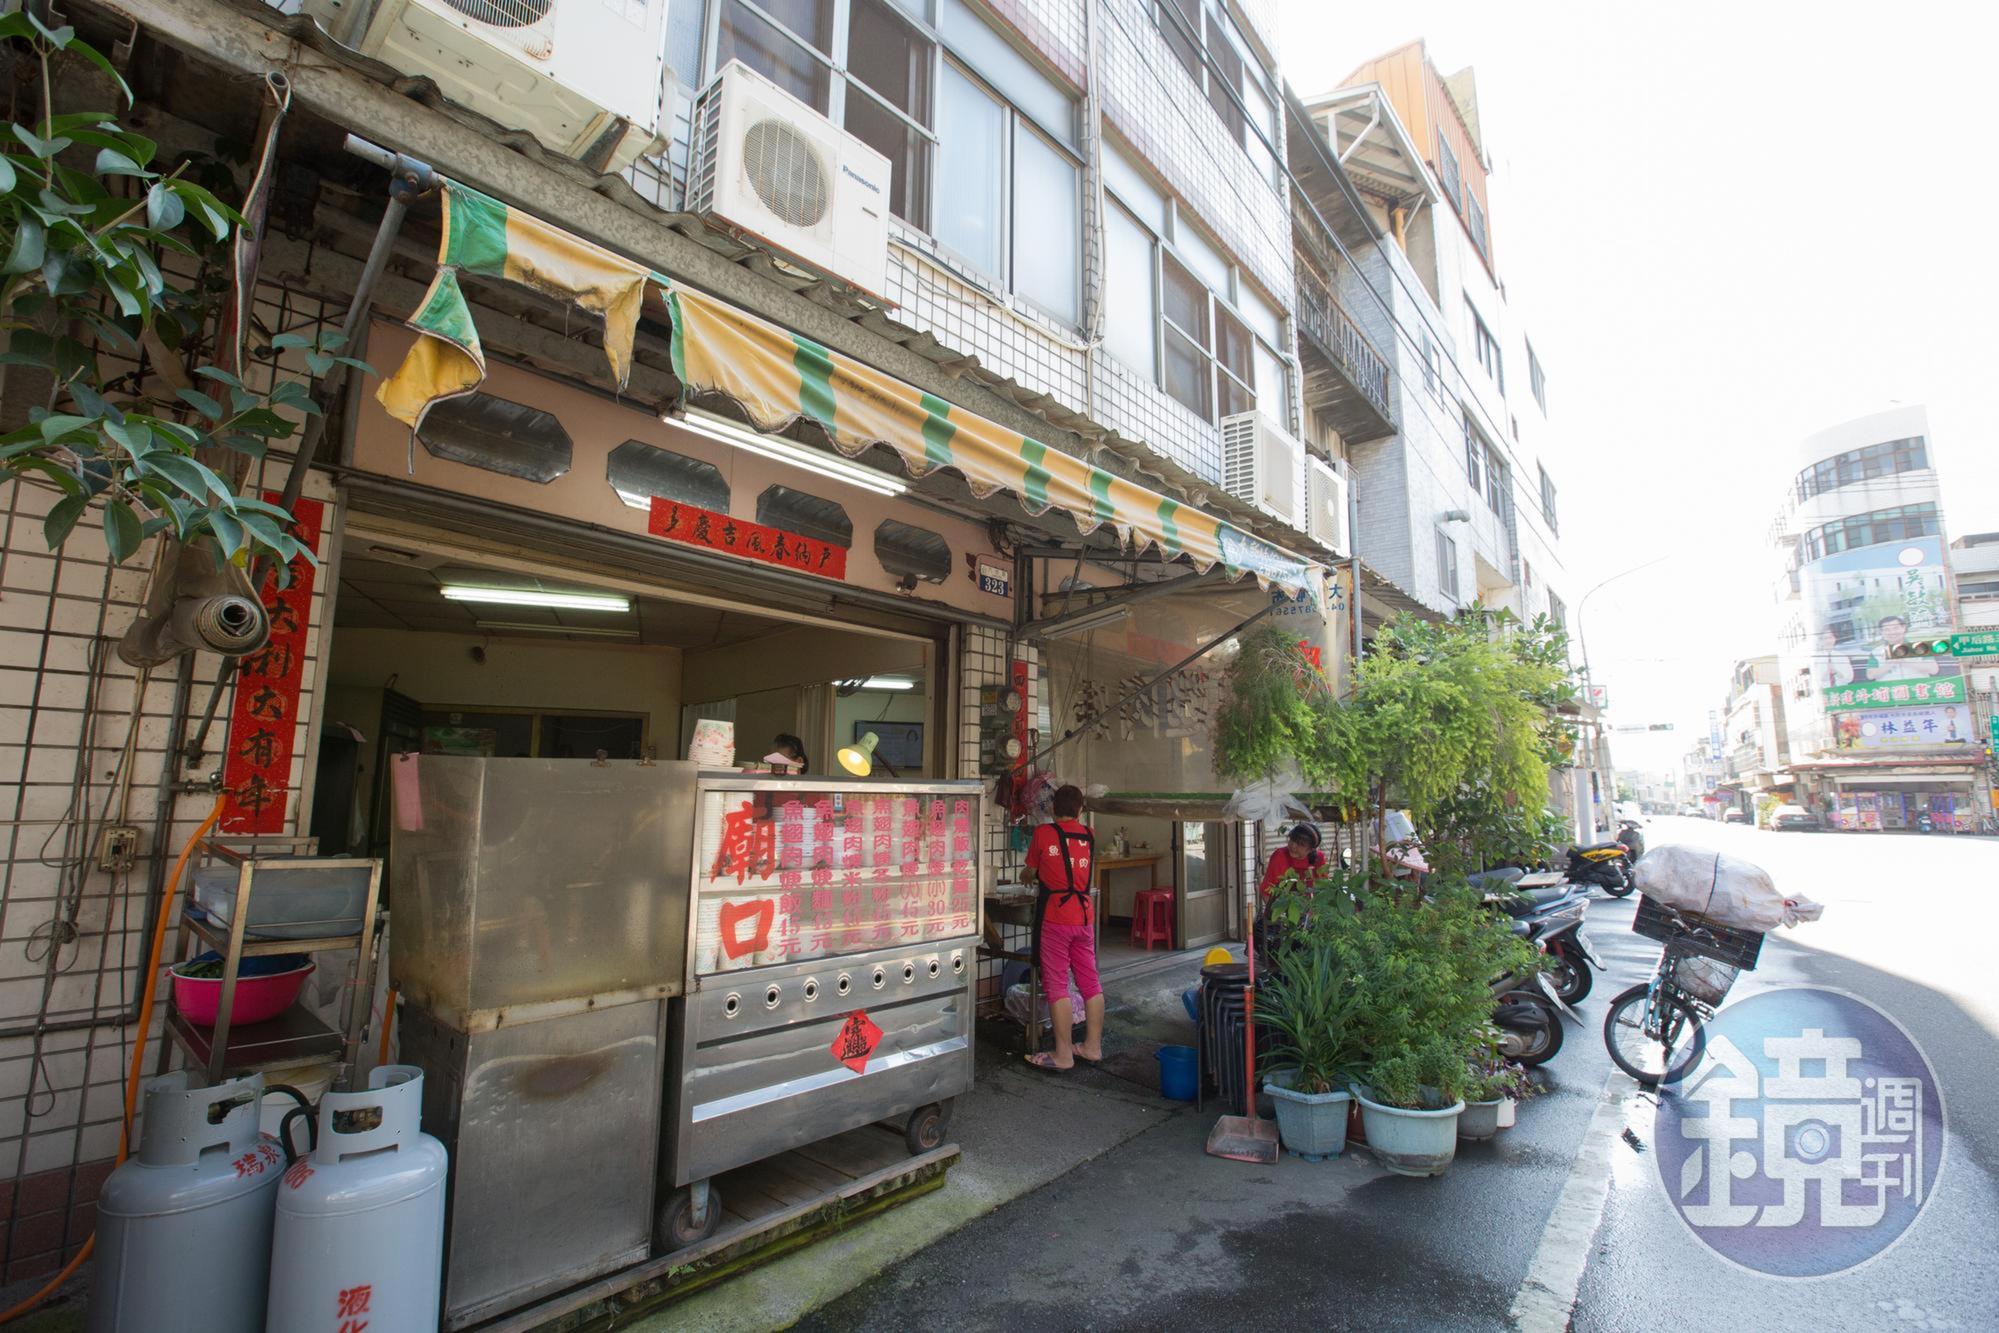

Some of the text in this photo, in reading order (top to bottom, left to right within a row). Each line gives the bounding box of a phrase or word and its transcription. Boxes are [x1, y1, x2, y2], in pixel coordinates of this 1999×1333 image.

[843, 164, 880, 194] Panasonic
[984, 577, 1004, 595] 323
[233, 515, 311, 818] 大利大有年
[710, 800, 776, 961] 廟口
